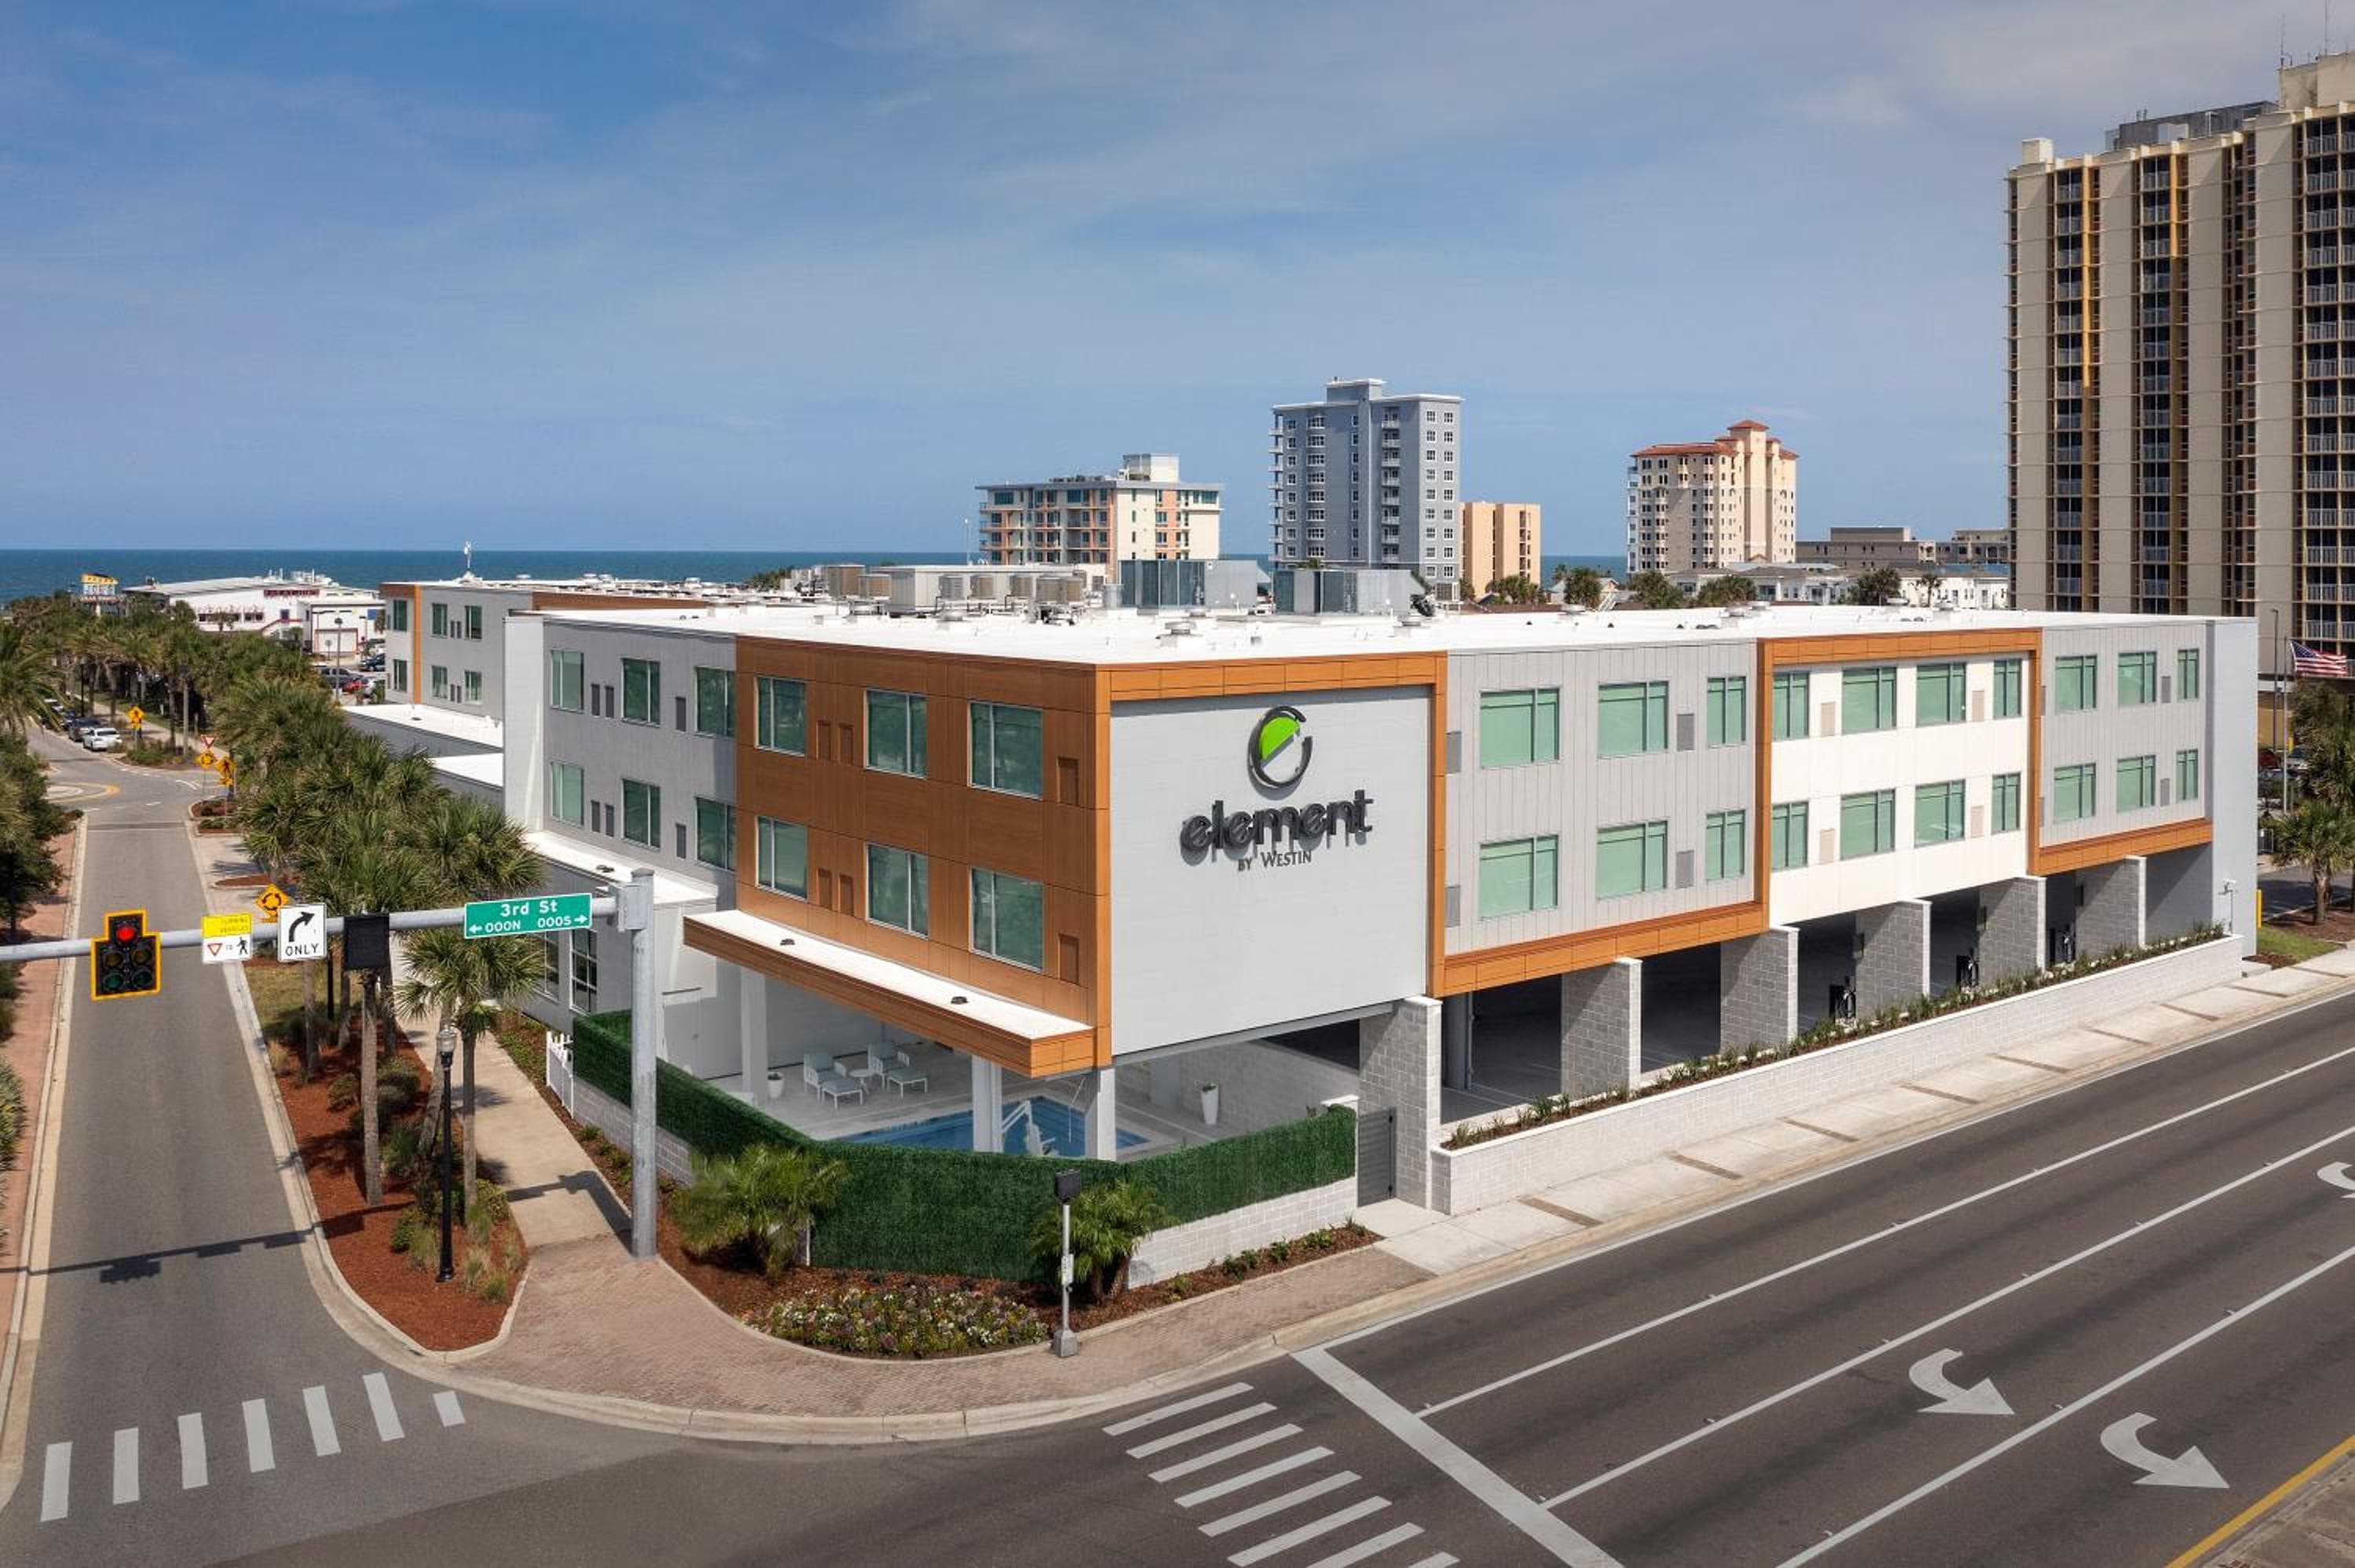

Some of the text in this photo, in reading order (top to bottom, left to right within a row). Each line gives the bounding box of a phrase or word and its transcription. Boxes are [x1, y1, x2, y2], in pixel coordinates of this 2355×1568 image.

[1181, 789, 1374, 851] element
[500, 900, 558, 917] 3rd St
[485, 915, 572, 933] 000N 000S
[285, 943, 319, 957] ONLY
